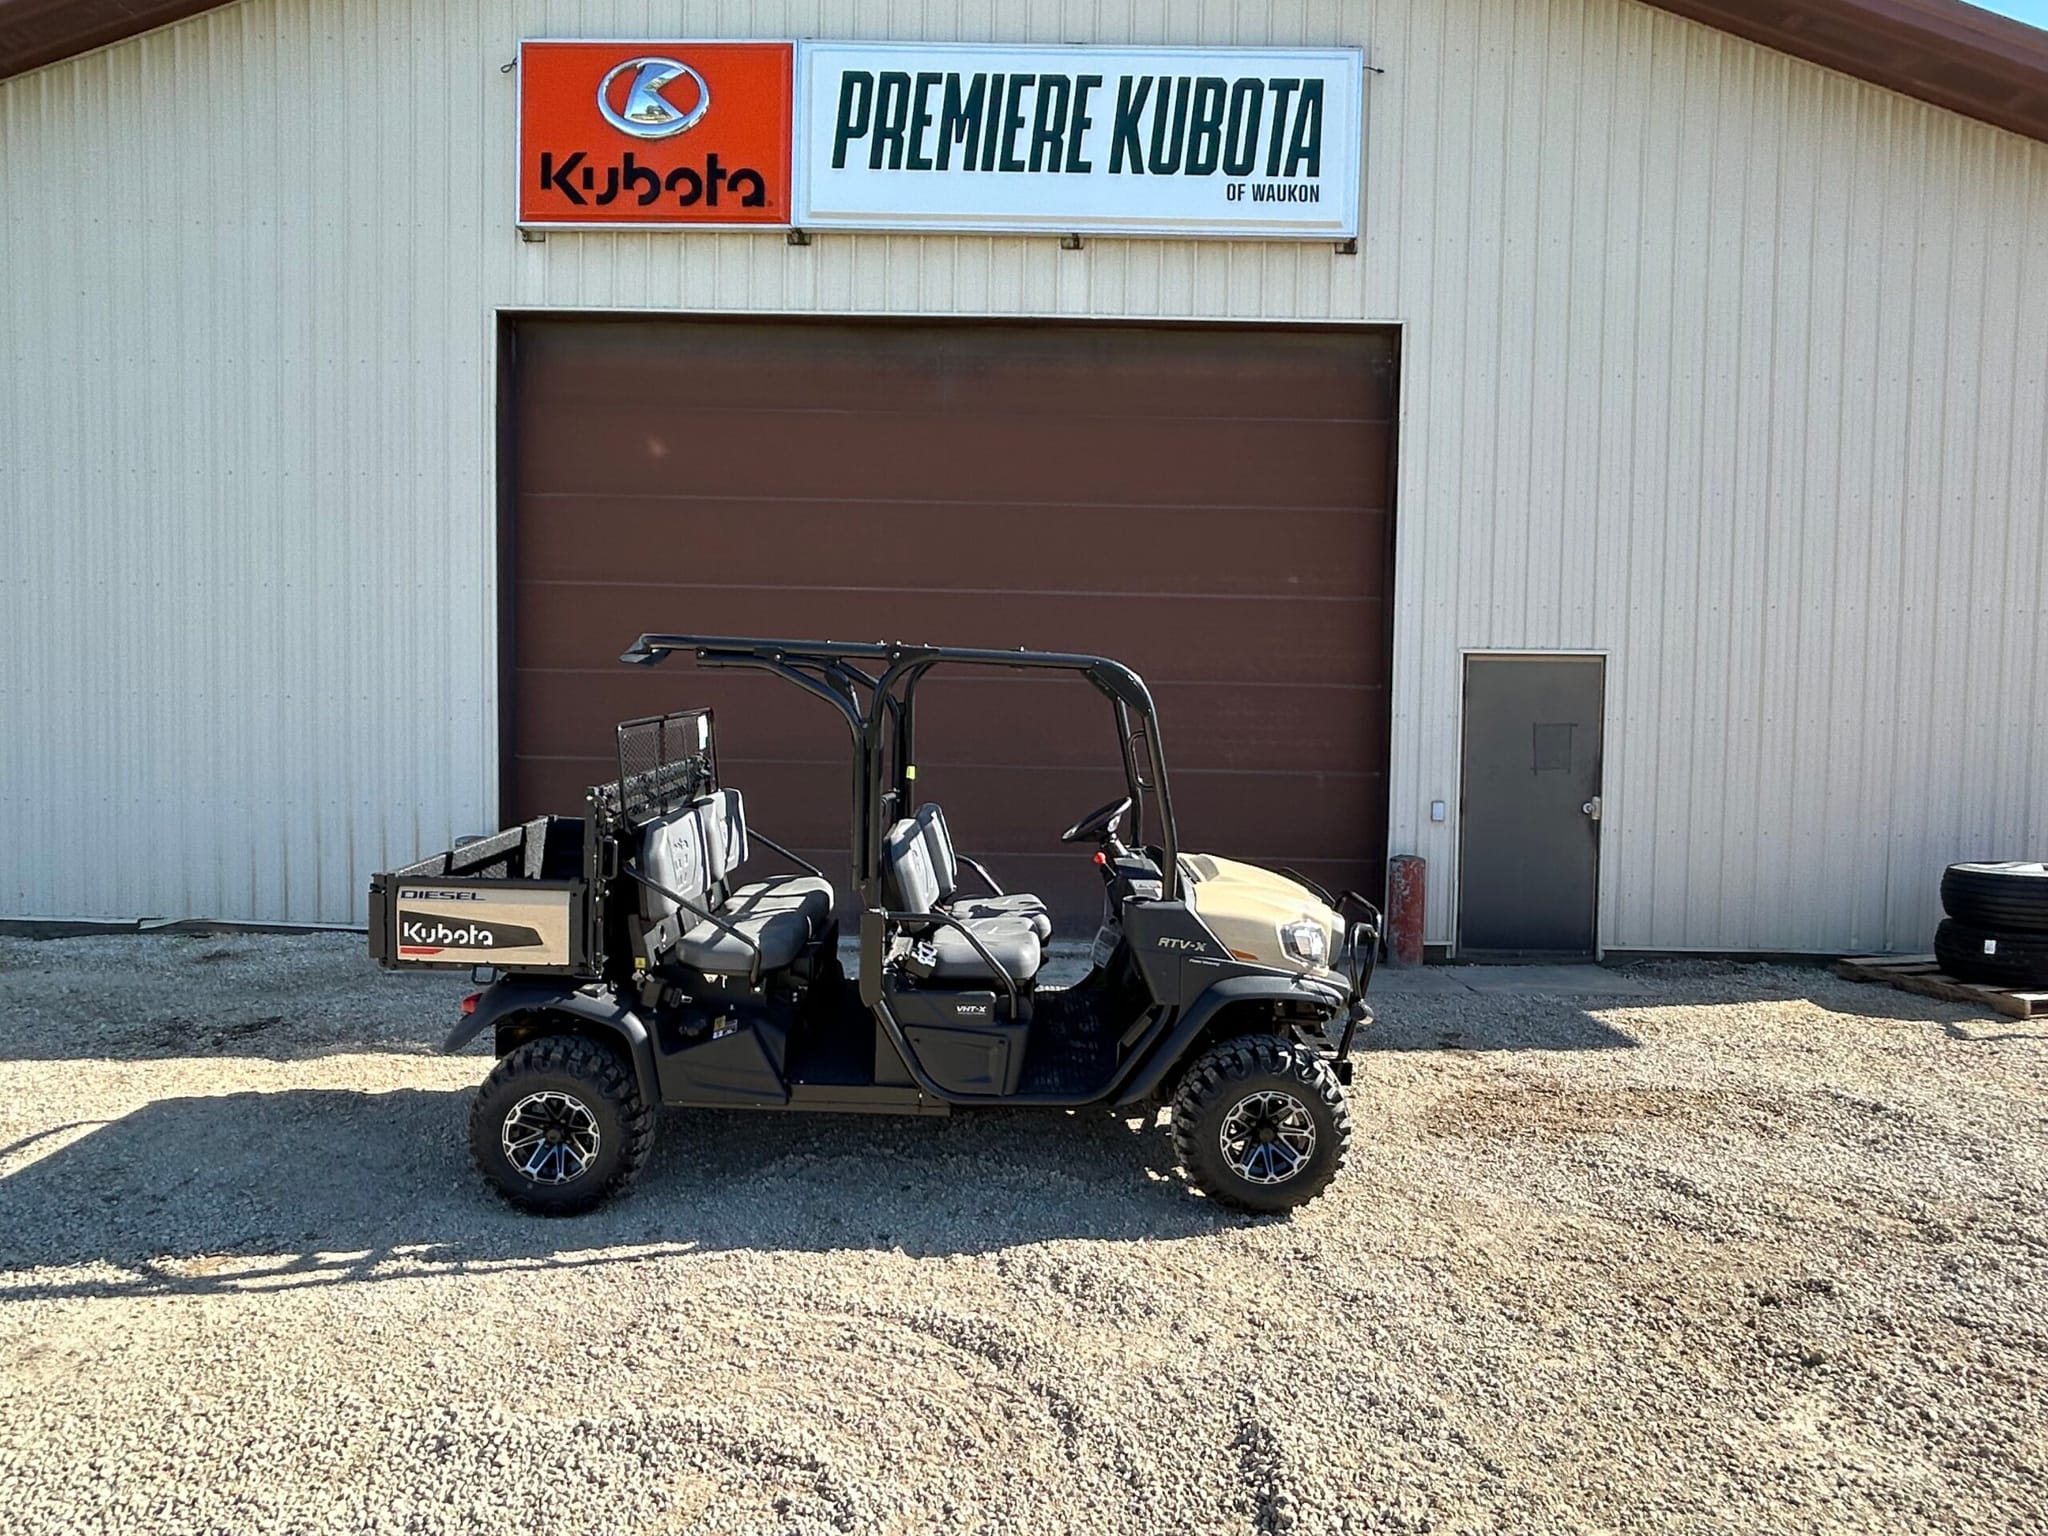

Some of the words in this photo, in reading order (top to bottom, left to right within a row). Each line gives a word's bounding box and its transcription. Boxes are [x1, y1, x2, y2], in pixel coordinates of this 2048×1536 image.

[831, 70, 1103, 174] PREMIERE
[1108, 75, 1324, 178] KUBOTA
[540, 151, 765, 208] Kubota
[1226, 183, 1246, 201] OF
[1252, 183, 1320, 203] WAUKON
[400, 890, 487, 901] DIESEL
[403, 921, 493, 946] Kubota
[1157, 937, 1207, 952] RTV-X
